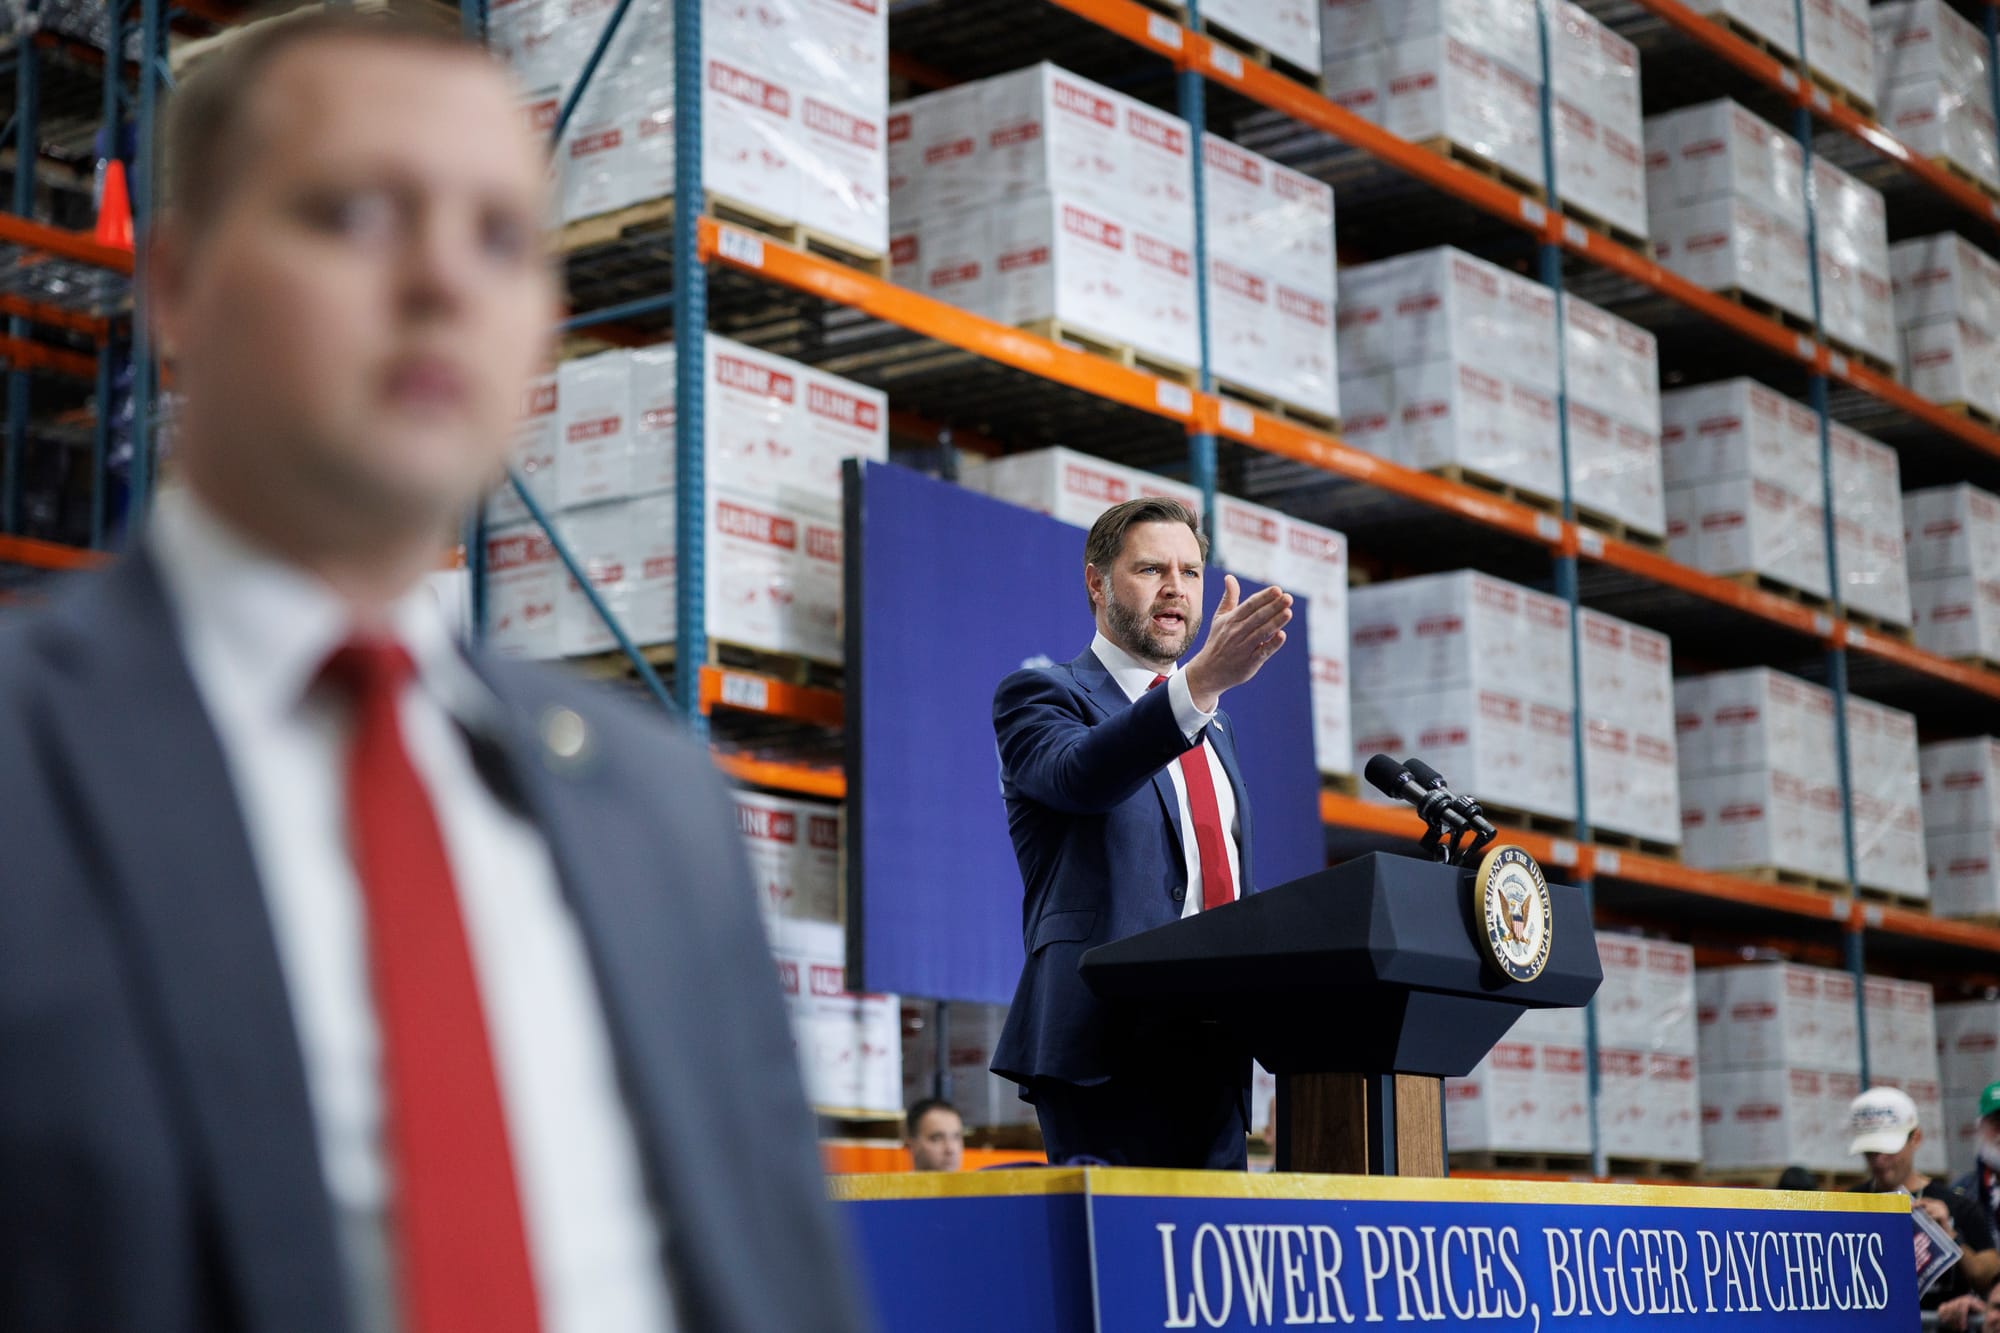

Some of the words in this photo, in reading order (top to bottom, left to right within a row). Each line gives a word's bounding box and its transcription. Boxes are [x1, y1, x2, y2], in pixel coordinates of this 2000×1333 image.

[1505, 850, 1513, 861] OF
[1515, 851, 1527, 865] THE
[1485, 855, 1504, 928] PRESIDENT
[1529, 862, 1549, 919] UNITED
[1493, 941, 1510, 971] VICE
[1531, 928, 1549, 974] STATES
[1156, 1222, 1355, 1328] LOWER
[1355, 1225, 1540, 1333] PRICES,
[1542, 1227, 1697, 1317] BIGGER
[1697, 1230, 1889, 1313] PAYCHECKS
